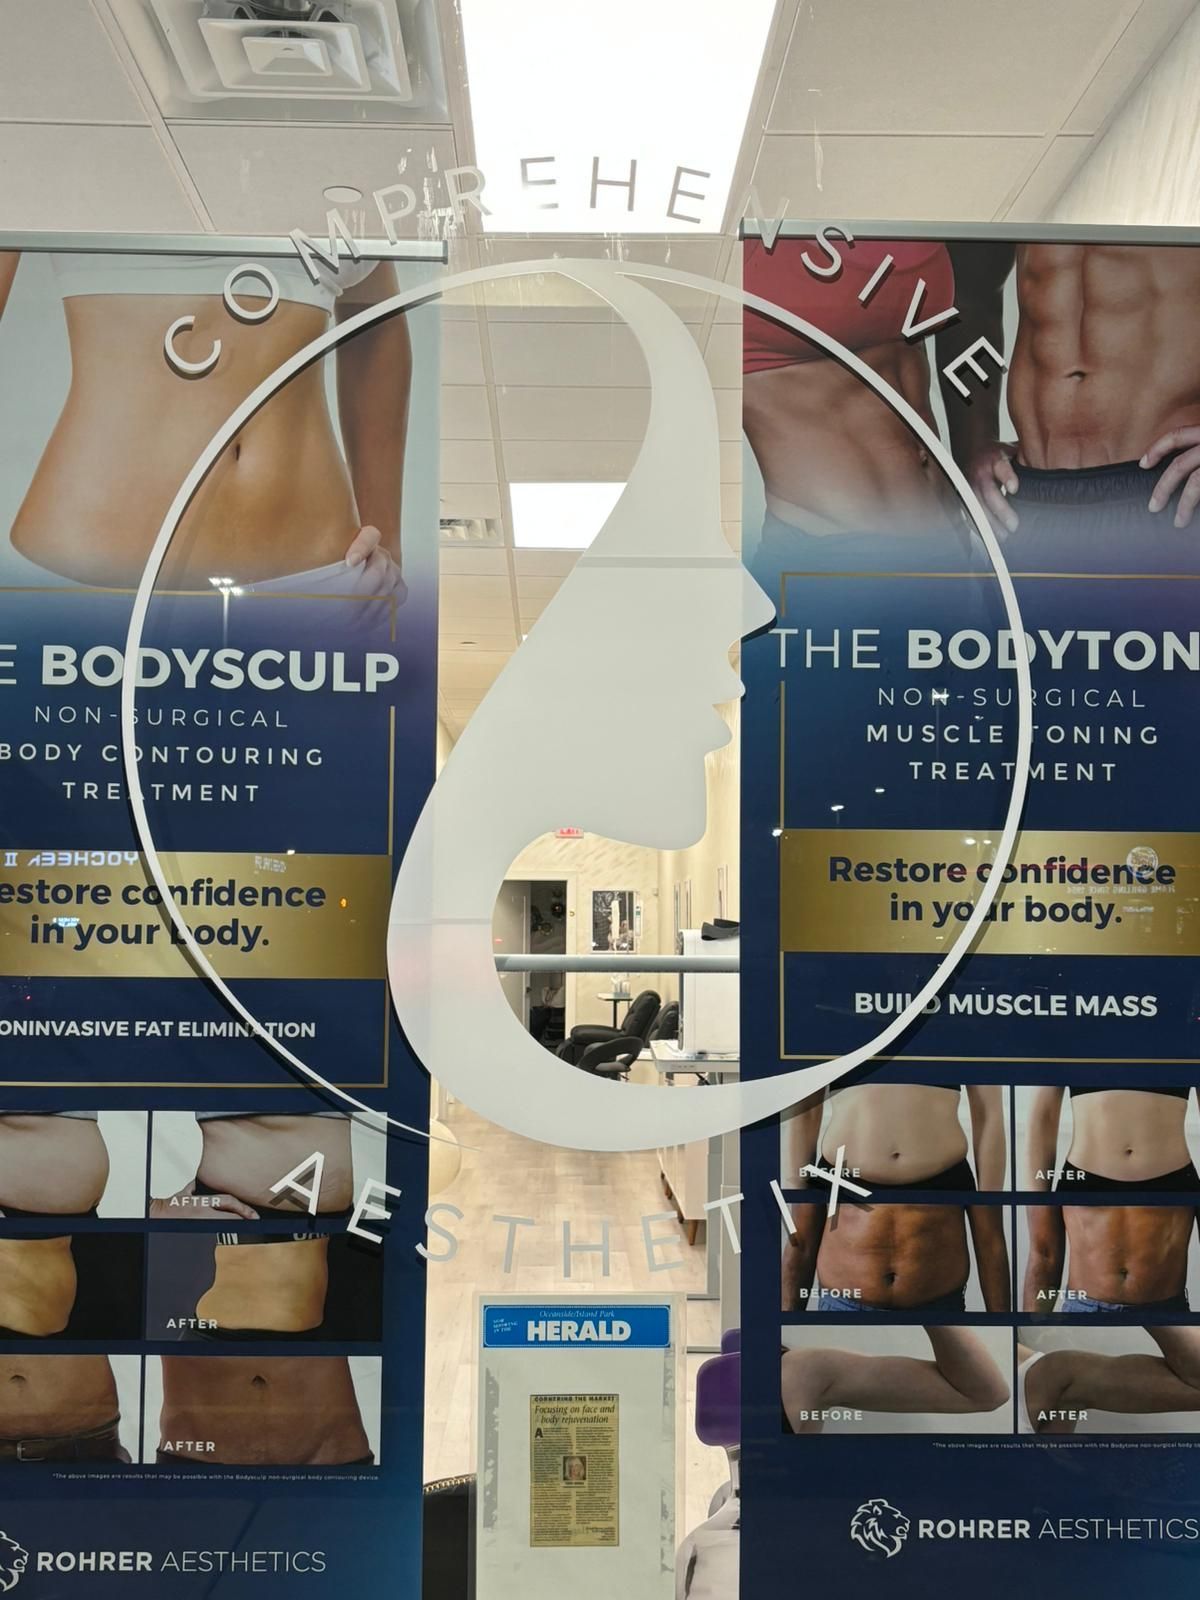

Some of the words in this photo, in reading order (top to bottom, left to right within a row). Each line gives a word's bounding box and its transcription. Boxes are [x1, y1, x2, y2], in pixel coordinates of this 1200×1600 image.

[165, 156, 1007, 398] COMPREHENSIVE
[770, 628, 880, 669] THE
[907, 628, 1200, 671] BODYTON
[42, 645, 400, 692] BODYSCULP
[867, 725, 1004, 744] MUSCLE
[0, 743, 83, 761] BODY
[909, 761, 1117, 782] TREATMENT
[62, 782, 260, 802] TRETMENT
[829, 856, 967, 883] Restore
[976, 855, 1176, 885] confidence
[0, 879, 112, 905] estore
[121, 877, 326, 907] confidence
[890, 893, 924, 921] in
[932, 900, 1015, 928] your
[1025, 895, 1122, 930] body.
[31, 914, 64, 944] in
[73, 923, 160, 951] your
[170, 916, 270, 952] body.
[949, 994, 1068, 1017] MUSCLE
[1075, 995, 1158, 1017] MASS
[0, 1019, 129, 1037] ONINVASIVE
[135, 1021, 174, 1037] FAT
[1035, 1169, 1087, 1181] AFTER
[169, 1196, 222, 1208] AFTER
[270, 1144, 872, 1278] AESTHETIX
[799, 1287, 863, 1300] BEFORE
[1036, 1289, 1088, 1301] AFTER
[166, 1318, 219, 1330] AFTER
[527, 1320, 632, 1342] HERALD
[535, 1405, 568, 1414] Focusing
[582, 1405, 598, 1414] face
[599, 1404, 616, 1413] and
[799, 1410, 863, 1421] BEFORE
[1037, 1410, 1089, 1421] AFTER
[541, 1415, 560, 1425] body
[561, 1415, 609, 1425] rejuvenation
[163, 1441, 216, 1452] AFTER
[918, 1519, 1030, 1539] ROHRER
[1038, 1518, 1199, 1539] AESTHETICS
[36, 1551, 152, 1572] ROHRER
[160, 1551, 326, 1572] AESTHETICS
